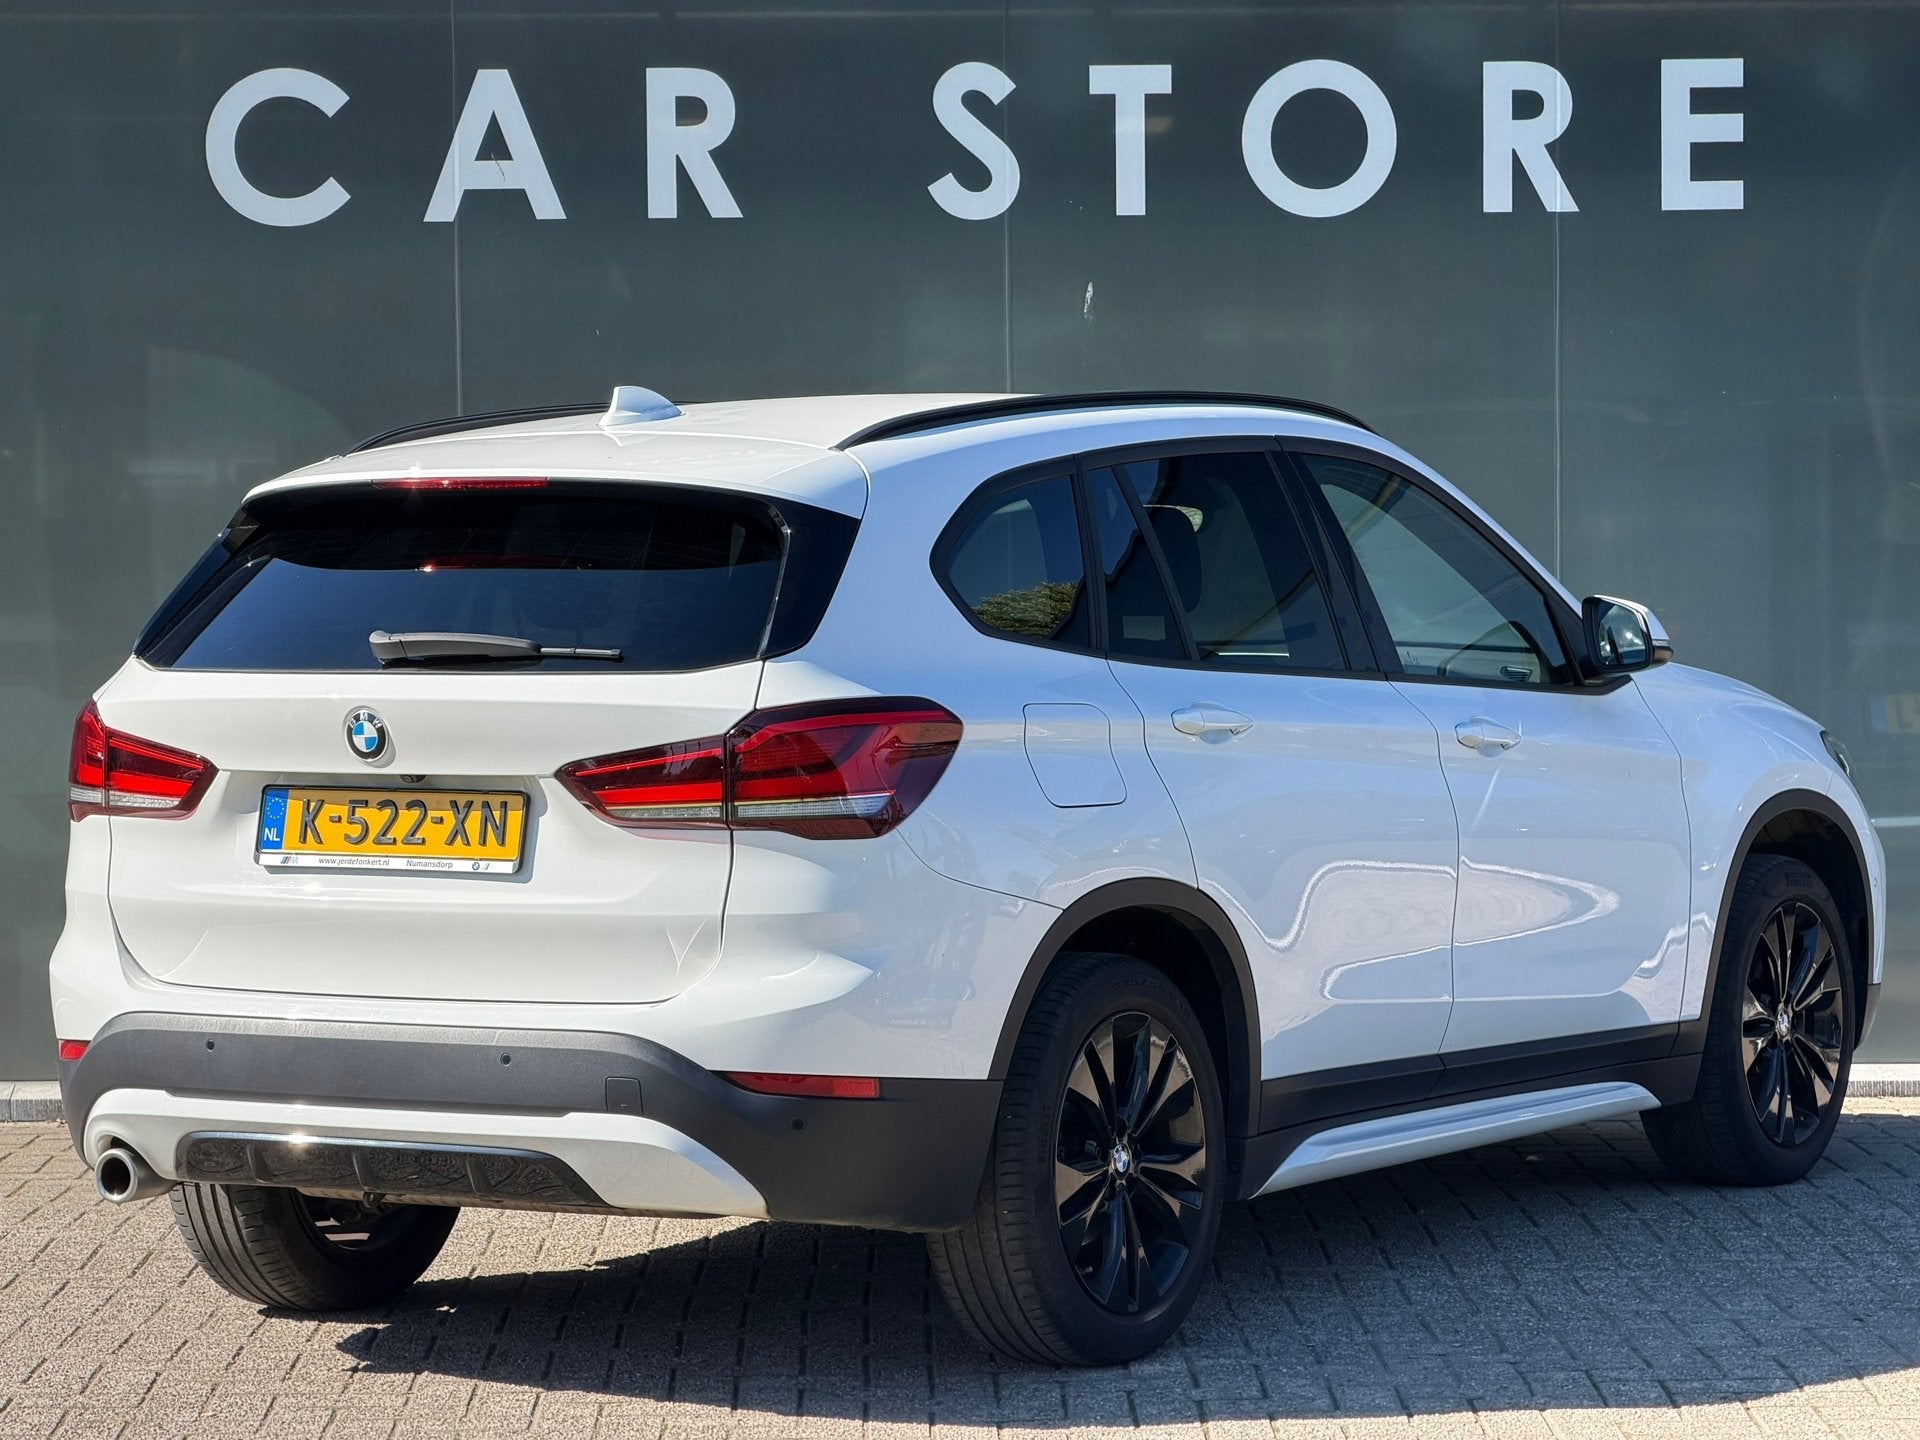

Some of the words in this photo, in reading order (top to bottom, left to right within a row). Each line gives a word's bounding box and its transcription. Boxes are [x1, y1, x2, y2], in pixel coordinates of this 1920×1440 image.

[205, 67, 744, 228] CAR
[927, 57, 1744, 220] STORE
[348, 711, 382, 729] BMW
[298, 799, 507, 847] K-522-XN
[264, 826, 281, 842] NL
[406, 860, 454, 869] Numansdorp
